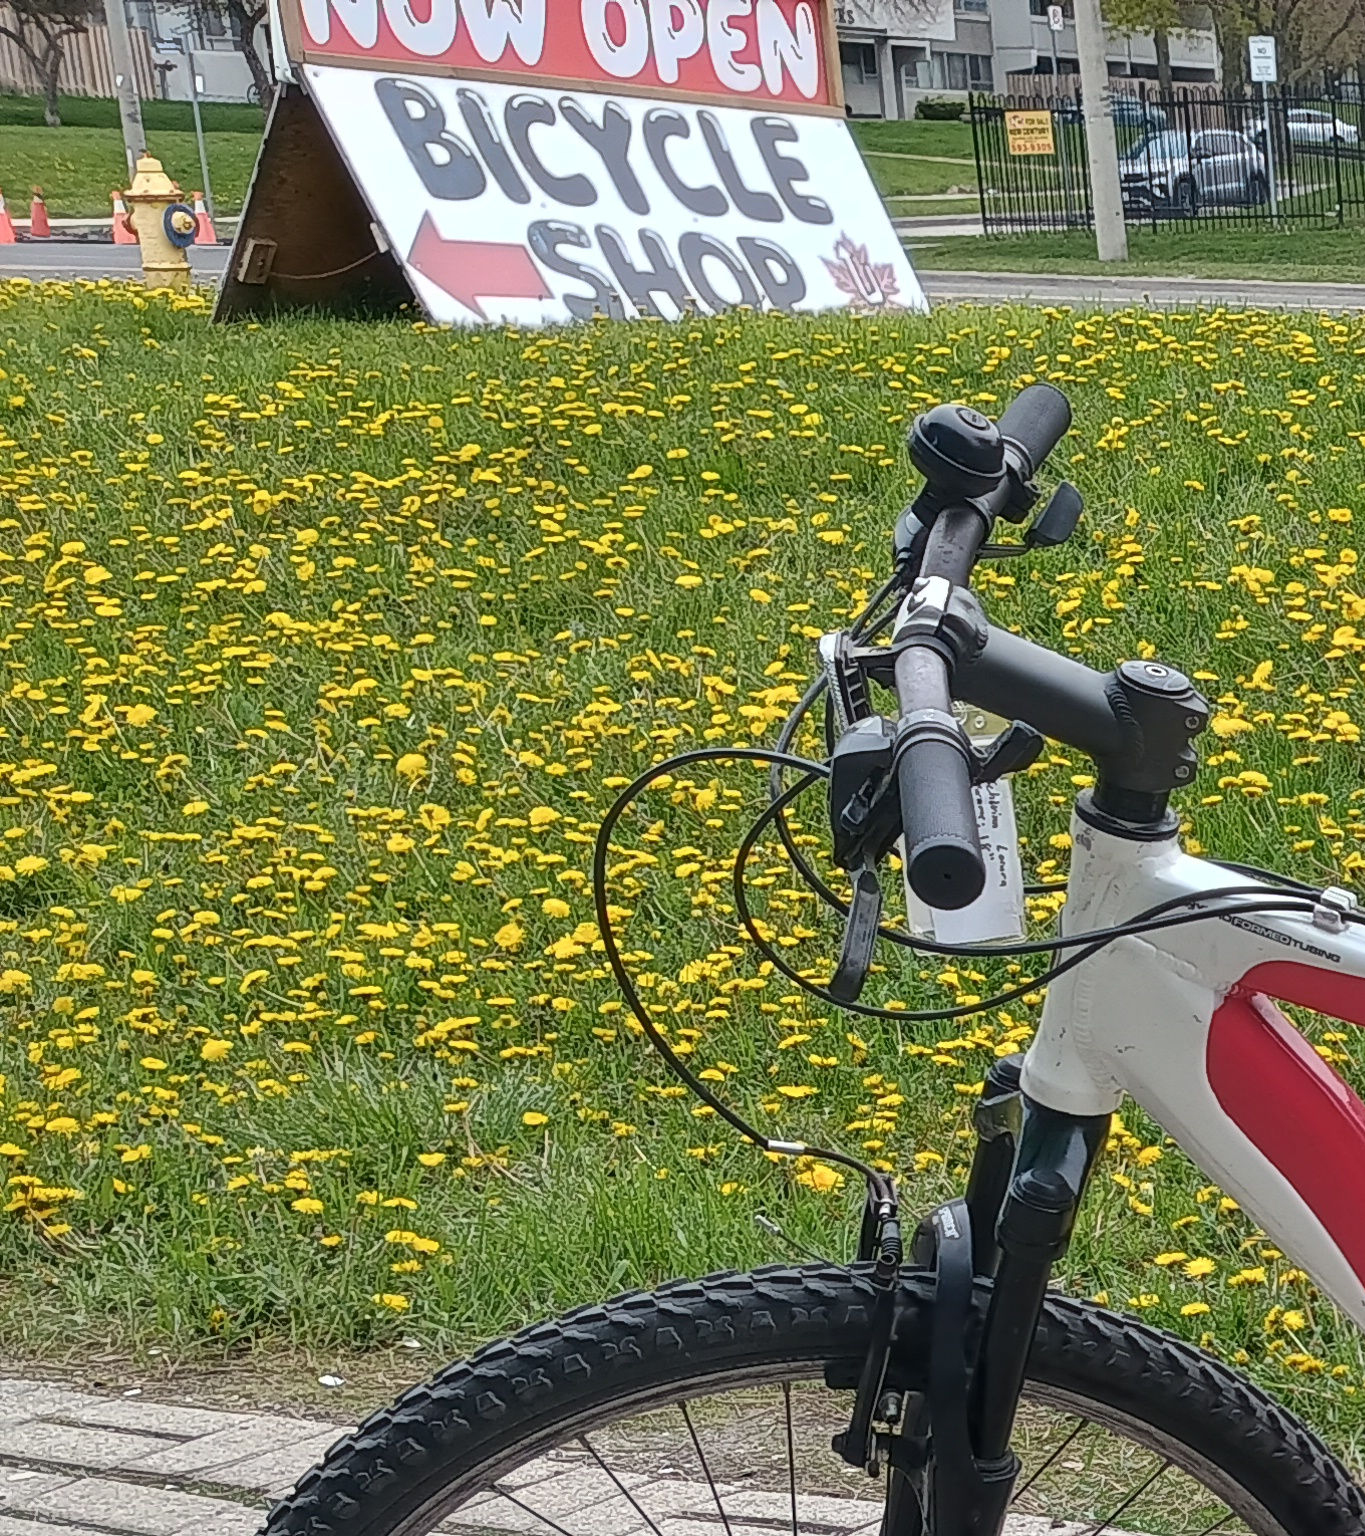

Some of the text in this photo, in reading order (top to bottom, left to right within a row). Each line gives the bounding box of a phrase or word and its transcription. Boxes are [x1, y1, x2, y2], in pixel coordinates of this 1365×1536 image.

[581, 0, 819, 99] OPEN
[375, 77, 834, 225] BICYCLE
[528, 219, 807, 321] SHOP
[1233, 917, 1342, 964] FORMED TUBING
